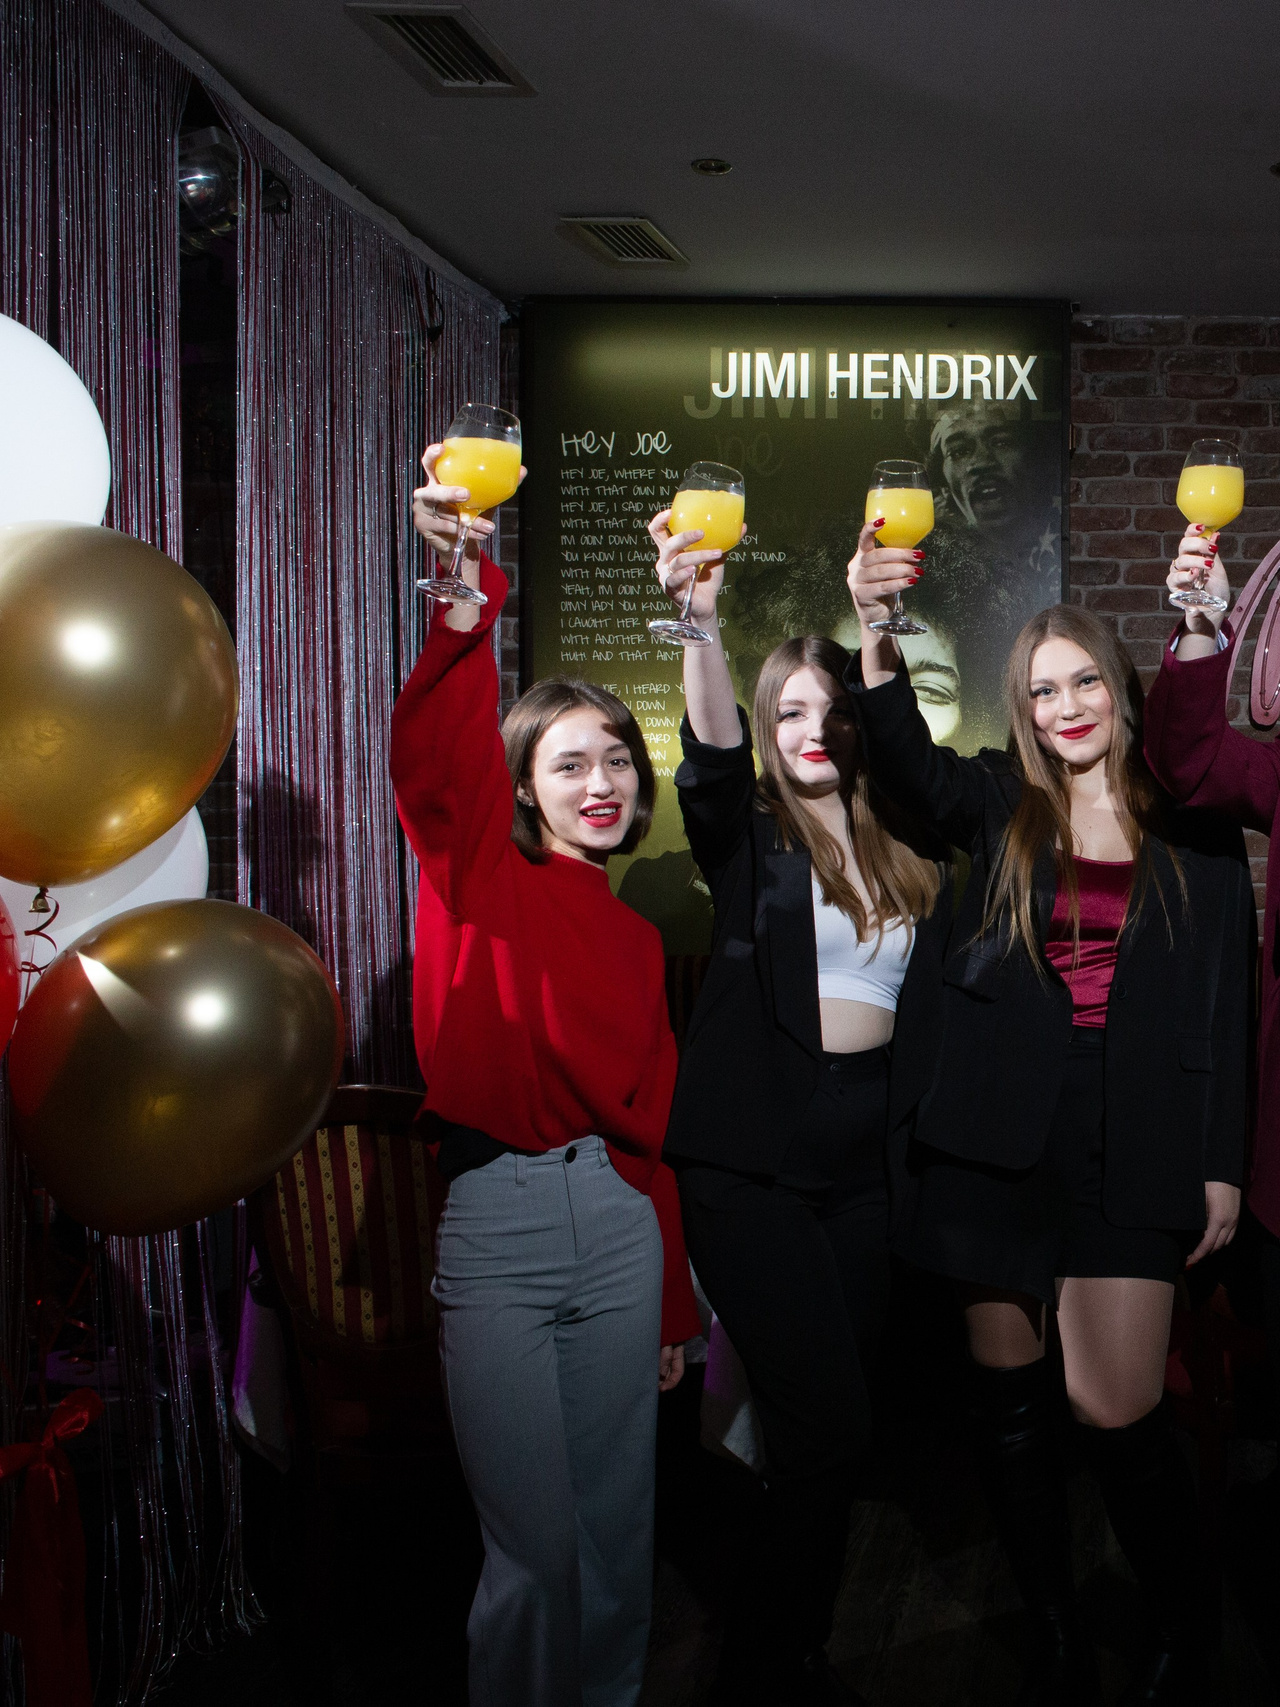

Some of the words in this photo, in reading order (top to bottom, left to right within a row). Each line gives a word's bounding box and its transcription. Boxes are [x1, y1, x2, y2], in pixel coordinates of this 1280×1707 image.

[711, 352, 809, 399] JIMI
[828, 353, 1038, 401] HENDRIX
[561, 467, 584, 480] HEY
[588, 468, 610, 482] JOE,
[614, 468, 656, 480] WHERE
[660, 467, 679, 479] YOU
[561, 485, 590, 497] WITH
[595, 485, 628, 497] THAT
[632, 485, 655, 497] GUN
[659, 486, 670, 497] IN
[561, 501, 584, 513] HEY
[588, 501, 610, 515] JOE,
[621, 501, 645, 513] SAID
[648, 501, 674, 513] WHE
[561, 518, 590, 530] WITH
[595, 518, 628, 530] THAT
[608, 534, 638, 546] DOWN
[737, 534, 759, 546] ADY
[561, 550, 580, 562] YOU
[583, 550, 616, 562] KNOW
[627, 550, 661, 562] CAUGH
[561, 567, 590, 579] WITH
[594, 567, 647, 579] ANOTHER
[561, 583, 594, 598] YEAH,
[618, 600, 637, 612] YOU
[641, 600, 673, 612] KNOW
[568, 616, 613, 628] CAUGHT
[616, 617, 641, 629] HER
[561, 633, 590, 645] WITH
[595, 633, 647, 645] ANOTHER
[592, 650, 614, 661] AND
[618, 650, 651, 662] THAT
[633, 683, 671, 695] HEARD
[636, 700, 666, 711] DOWN
[645, 716, 676, 728] DOWN
[643, 733, 671, 744] EARD
